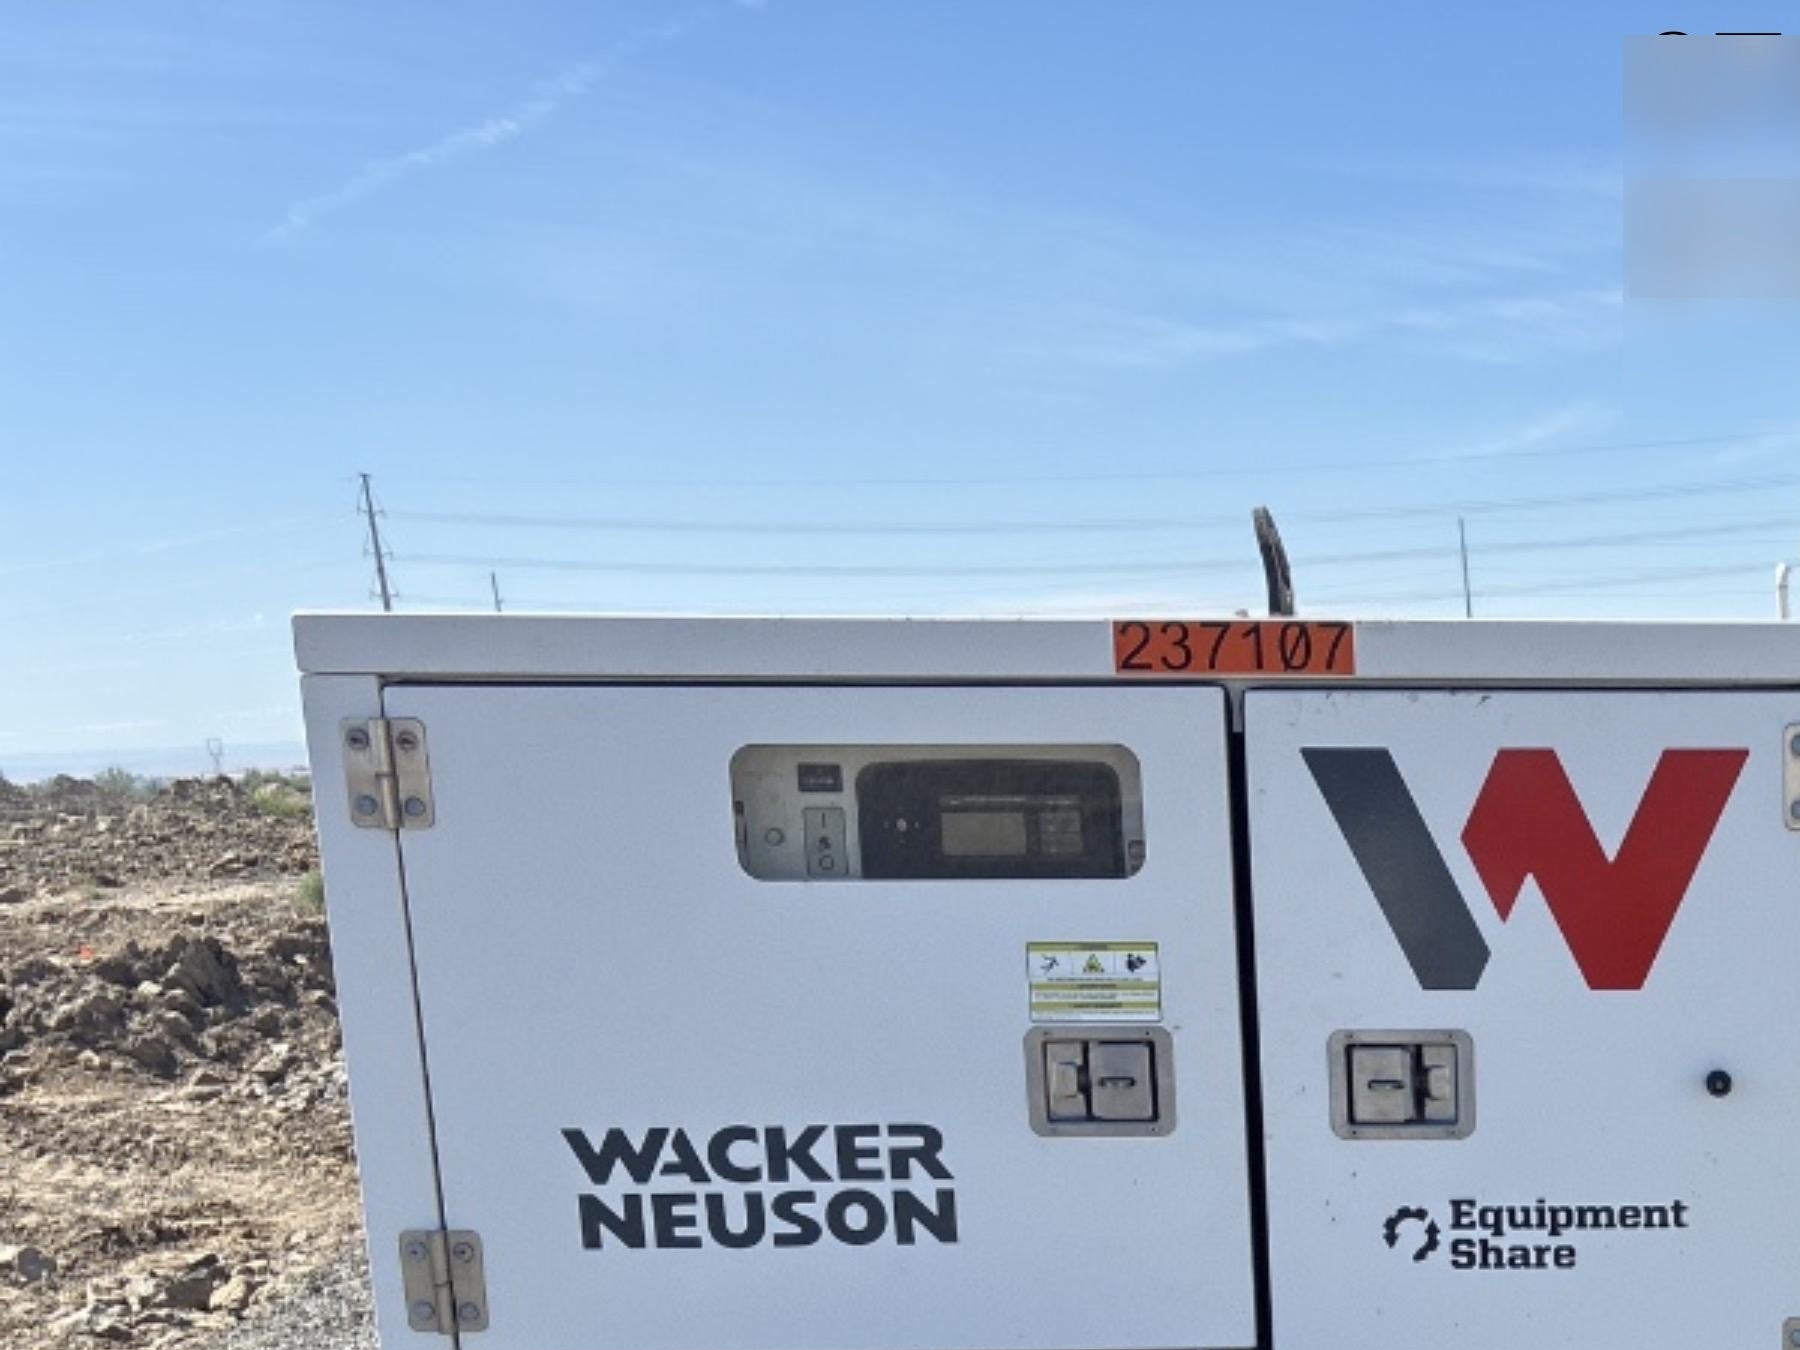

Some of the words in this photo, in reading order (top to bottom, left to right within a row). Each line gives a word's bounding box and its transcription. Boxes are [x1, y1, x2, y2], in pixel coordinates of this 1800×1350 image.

[1119, 621, 1348, 670] 237107
[560, 1124, 955, 1185] WACKER
[577, 1188, 958, 1249] NEUSON
[1449, 1199, 1689, 1237] Equipment
[1450, 1238, 1576, 1269] Share
